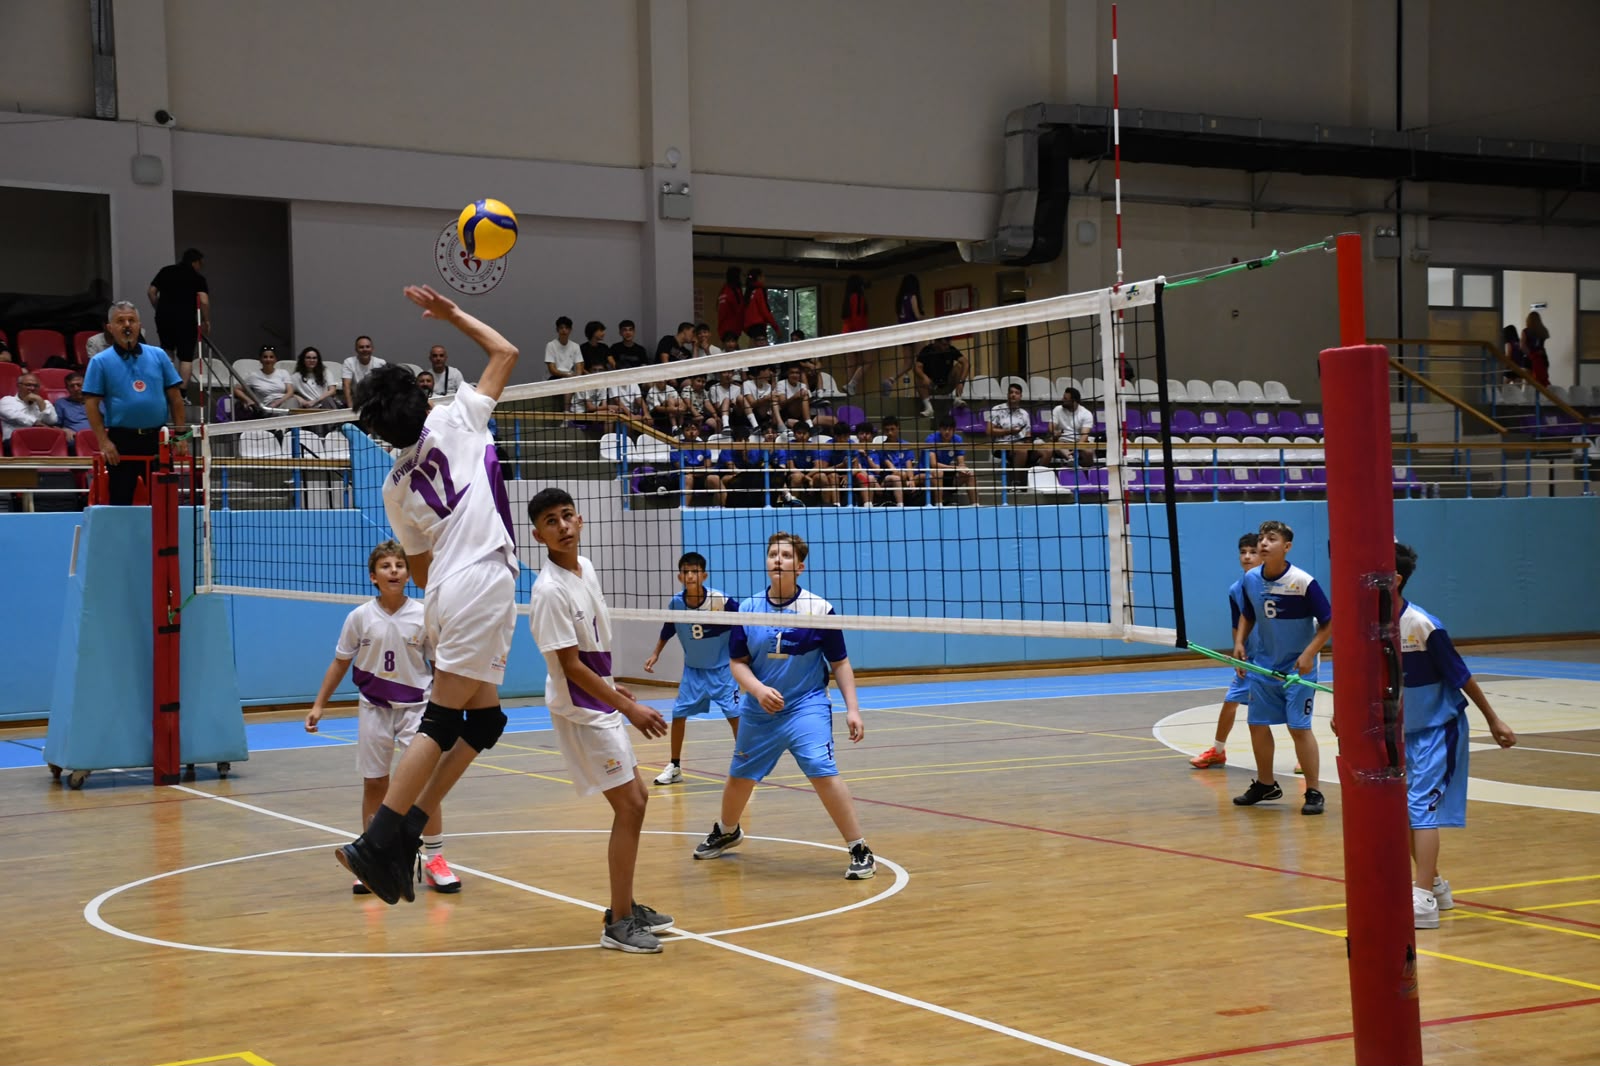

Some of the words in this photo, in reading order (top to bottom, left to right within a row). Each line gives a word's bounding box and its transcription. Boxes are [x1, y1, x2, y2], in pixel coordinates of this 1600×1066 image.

[409, 447, 471, 519] 12
[1264, 600, 1277, 618] 6
[691, 624, 704, 640] 8
[775, 631, 783, 654] 1
[384, 650, 395, 672] 8
[1304, 698, 1313, 715] 6
[1428, 788, 1442, 812] 2
